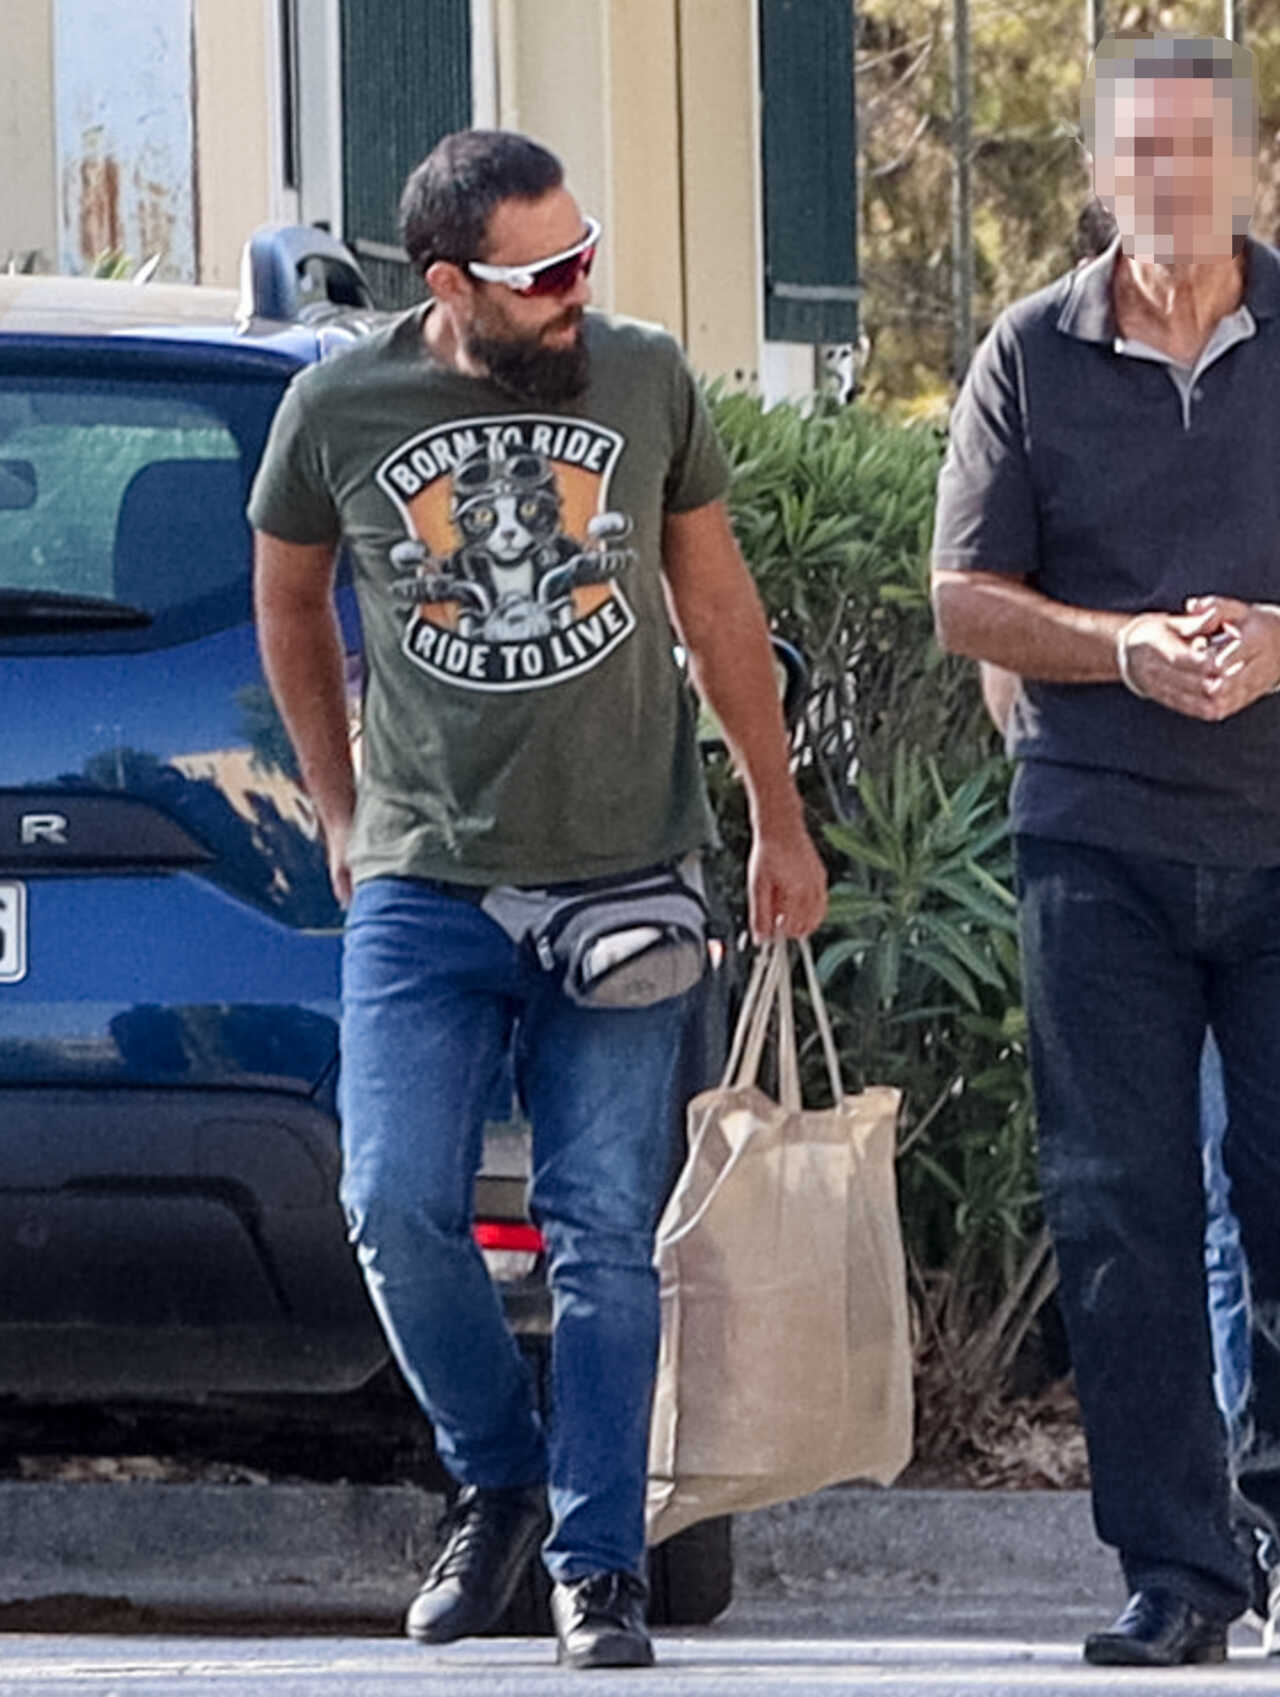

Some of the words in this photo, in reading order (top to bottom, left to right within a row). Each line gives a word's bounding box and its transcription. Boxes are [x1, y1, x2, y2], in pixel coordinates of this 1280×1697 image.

[389, 429, 479, 495] BORN
[484, 426, 524, 461] TO
[532, 424, 611, 471] RIDE
[415, 625, 489, 678] RIDE
[501, 643, 544, 679] TO
[551, 602, 624, 669] LIVE
[21, 814, 68, 844] R
